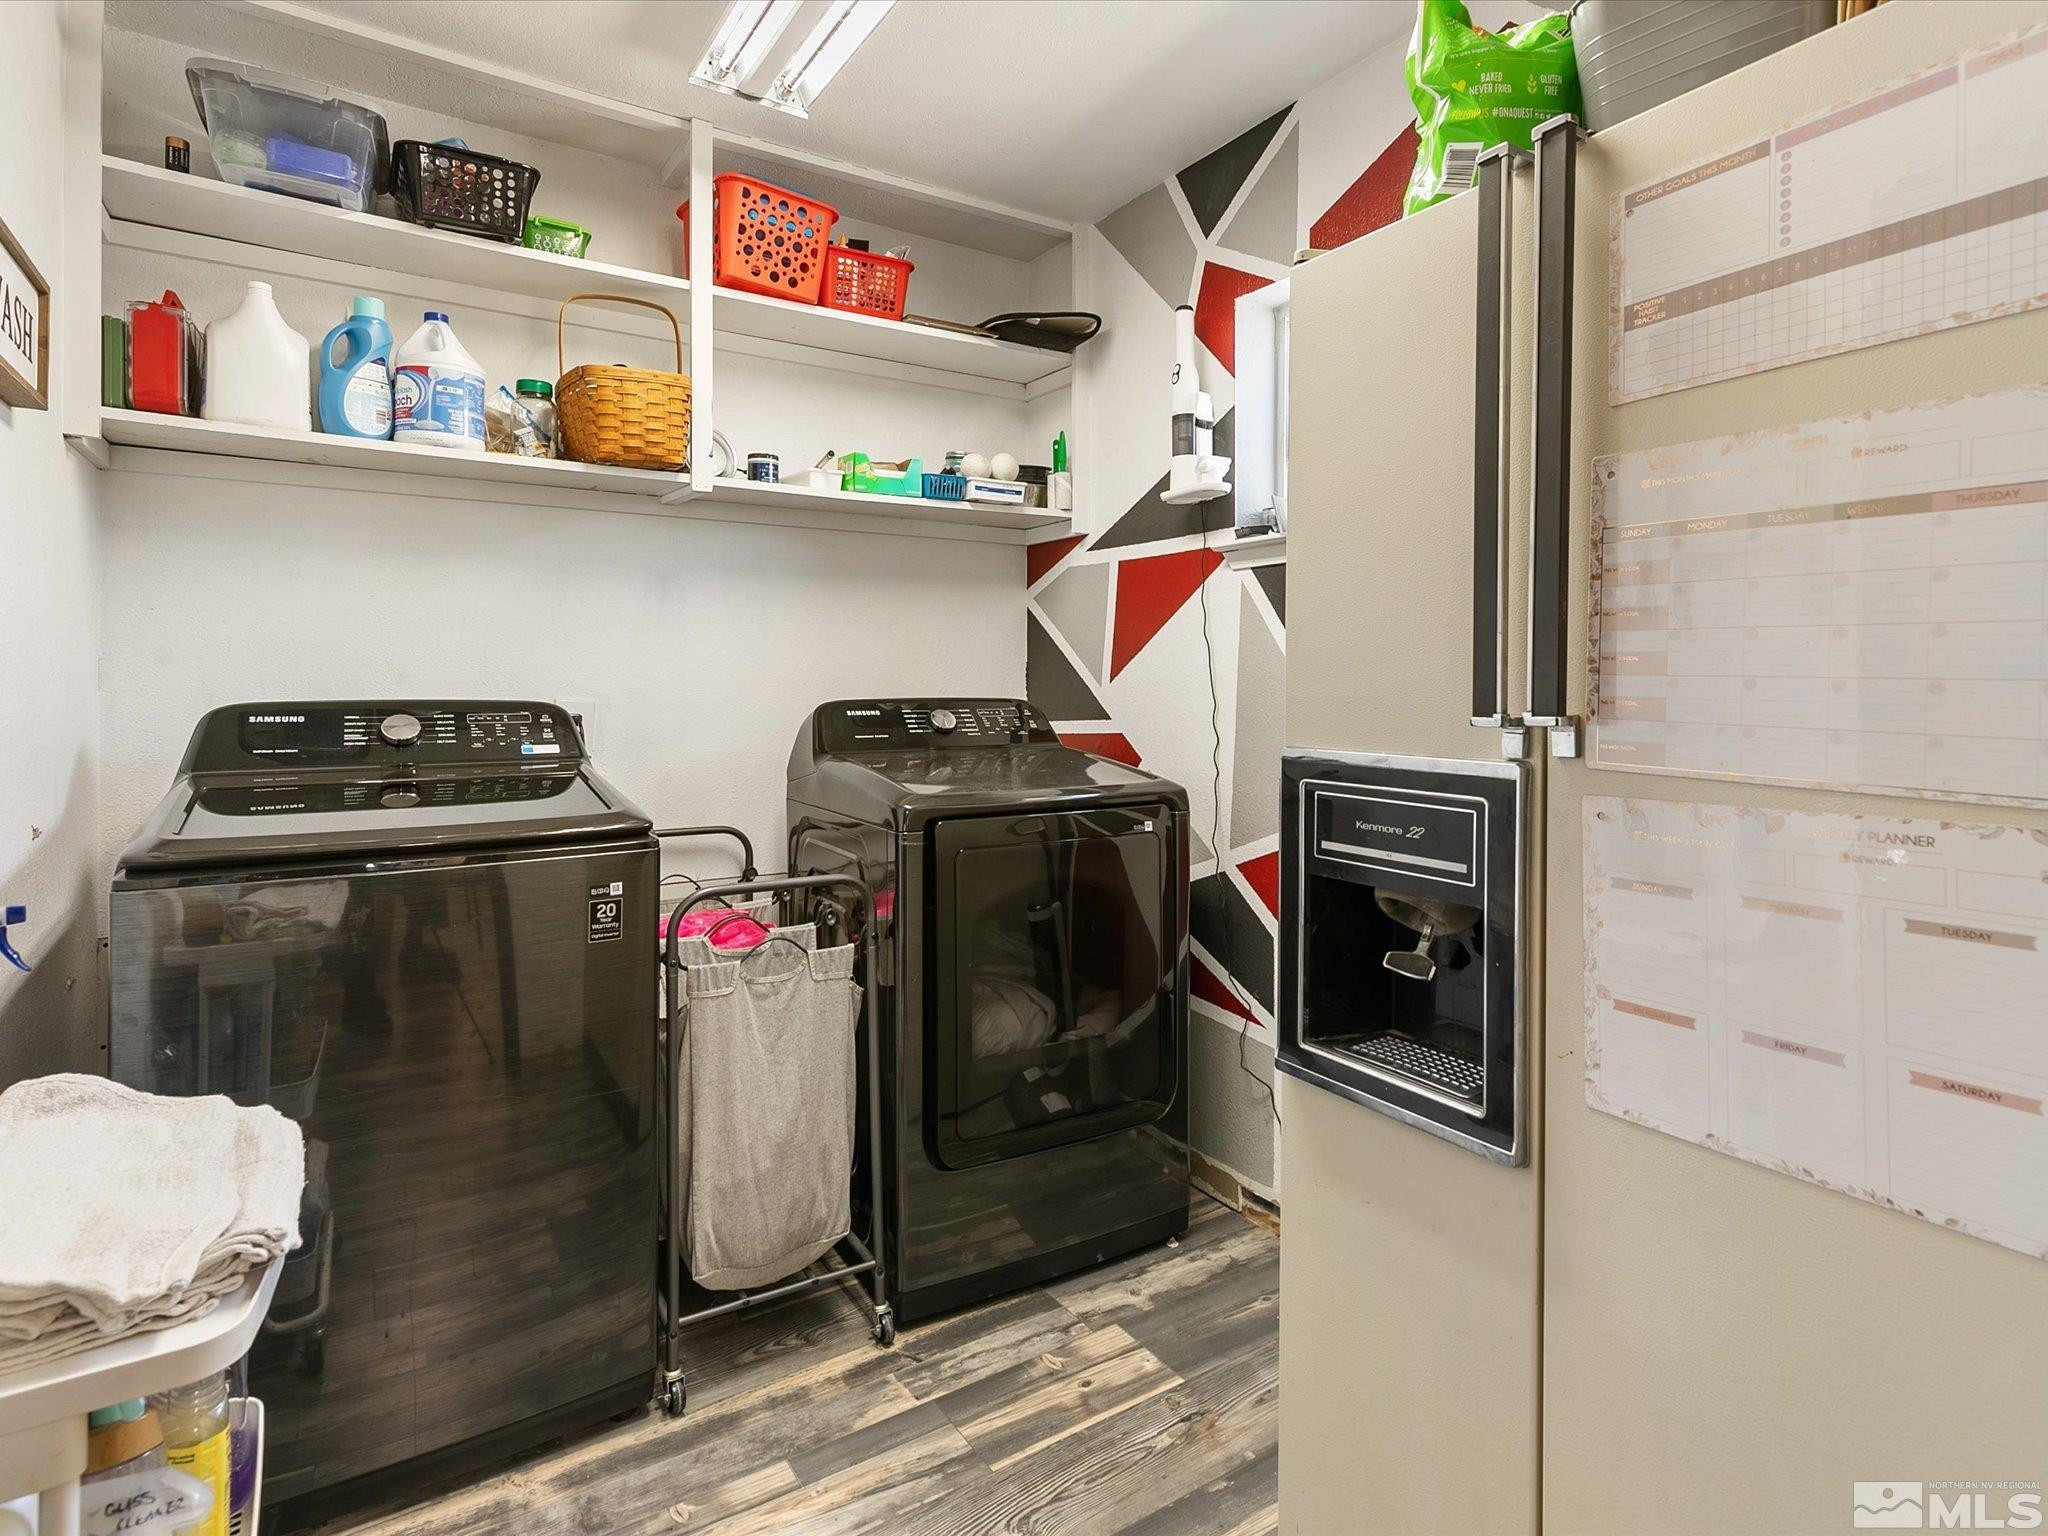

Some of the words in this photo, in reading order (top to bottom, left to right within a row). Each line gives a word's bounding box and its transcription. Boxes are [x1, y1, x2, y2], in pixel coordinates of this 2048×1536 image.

[1481, 72, 1503, 83] BAKED
[1540, 74, 1562, 85] GLUTEN
[1469, 84, 1493, 96] NEVER
[1494, 83, 1512, 95] FRIED
[1544, 85, 1558, 96] FREE
[1636, 186, 1664, 202] OTHER
[1665, 173, 1697, 191] GOALS
[1699, 165, 1718, 178] THIS
[1718, 149, 1757, 170] MONTH
[1633, 296, 1666, 313] POSITIVE
[0, 275, 33, 364] ASH
[1633, 312, 1667, 327] TRACKER
[1620, 528, 1652, 539] SUNDAY
[1687, 520, 1729, 532] MONDAY
[1767, 511, 1810, 523] TUESDAY
[1954, 488, 2022, 504] THURSDAY
[249, 715, 305, 723] SAMSUNG
[1355, 820, 1403, 835] Kenmore
[1405, 826, 1425, 839] 22
[1867, 831, 1936, 849] PLANNER
[1632, 882, 1664, 896] SUNDAY
[597, 903, 617, 918] 20
[591, 921, 620, 930] Warranty
[1941, 926, 1994, 942] TUESDAY
[1774, 1039, 1807, 1055] FRIDAY
[1942, 1080, 2003, 1102] SATURDAY
